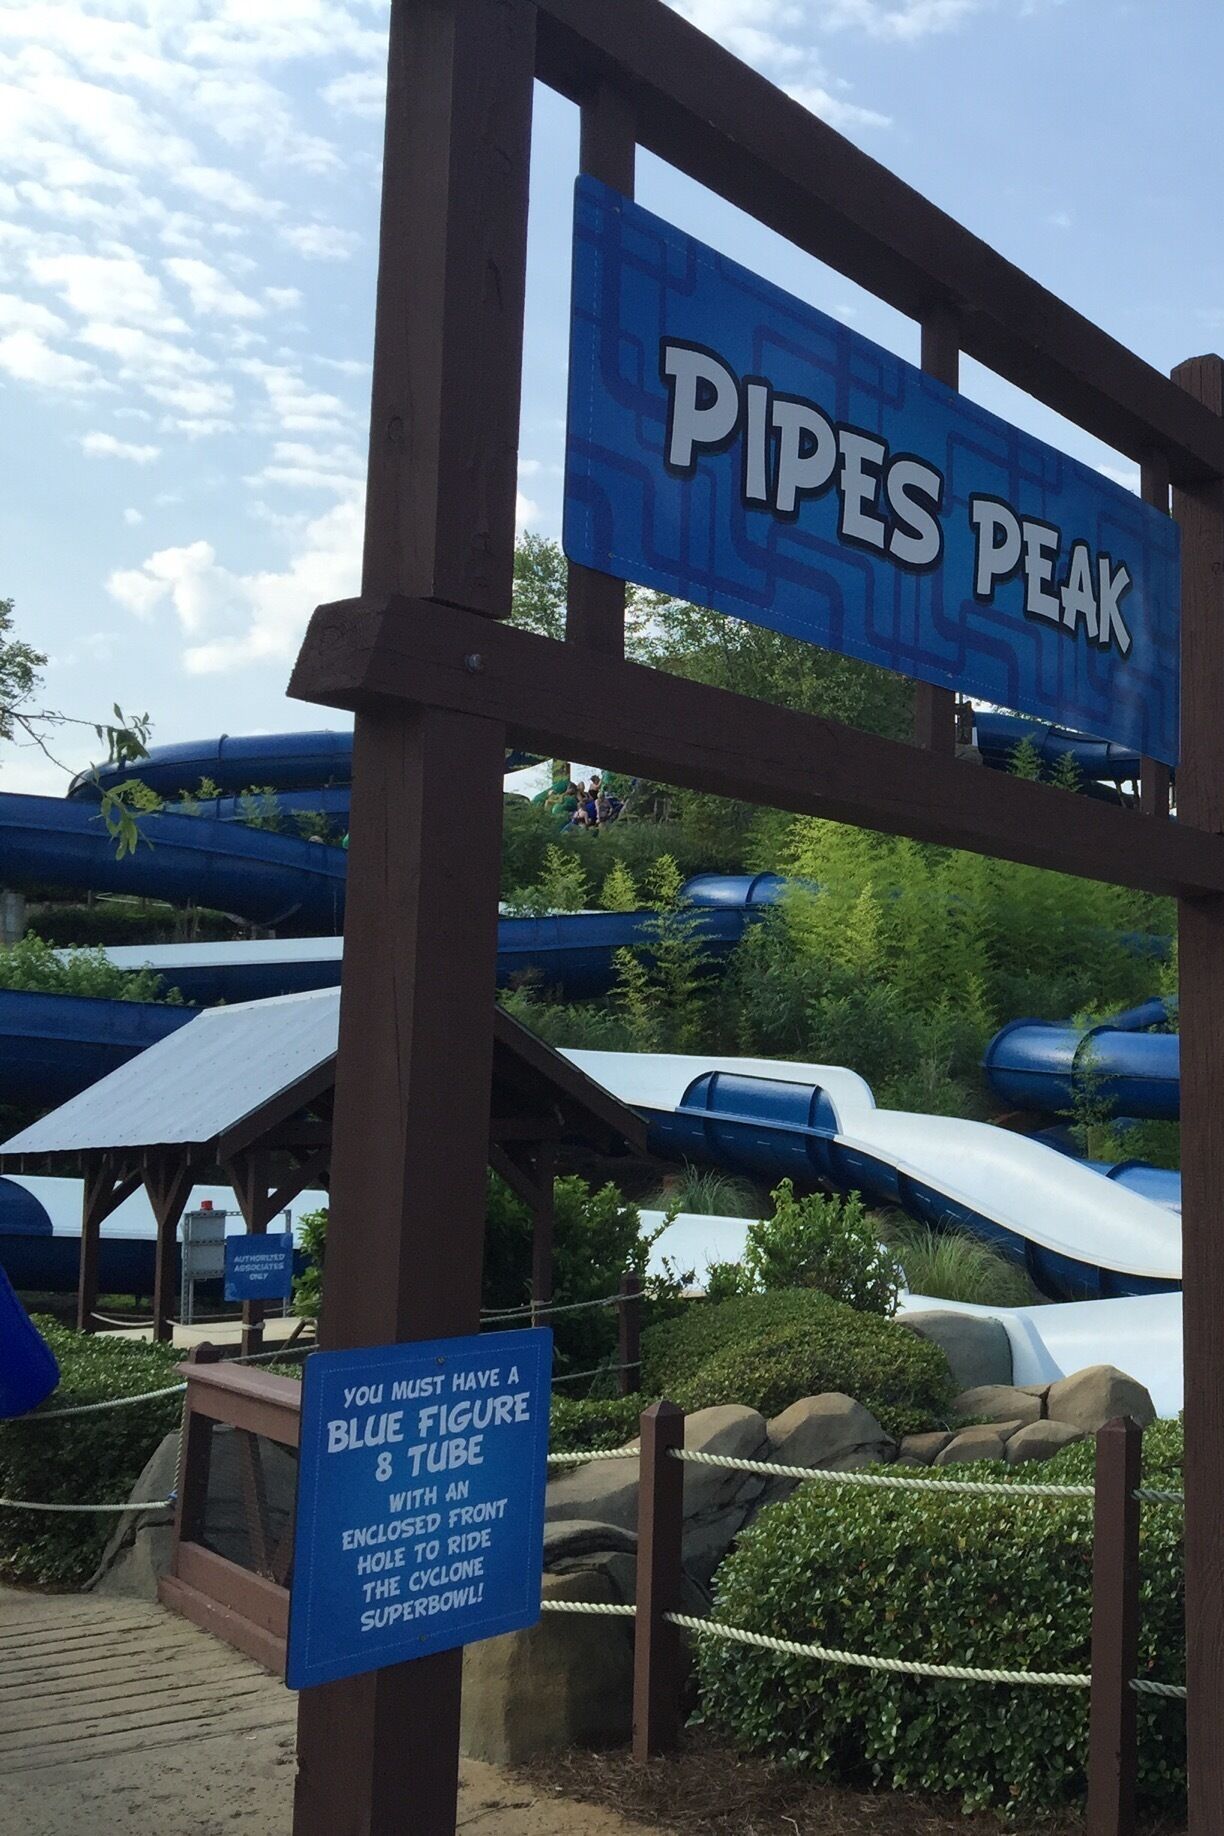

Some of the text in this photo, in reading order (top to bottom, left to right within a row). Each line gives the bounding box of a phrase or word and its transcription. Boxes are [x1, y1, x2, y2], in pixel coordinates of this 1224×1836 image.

[661, 340, 1133, 657] PIPES PEAK
[233, 1253, 286, 1263] AUTHORIZED
[233, 1261, 285, 1273] ASSOCIATES
[249, 1272, 269, 1281] ONLY
[344, 1365, 520, 1408] YOU MUST HAVE A
[327, 1392, 530, 1453] BLUE FIGURE
[375, 1434, 485, 1482] 8 TUBE
[389, 1480, 469, 1513] WITH AN
[342, 1499, 508, 1551] ENCLOSED FRONT
[357, 1528, 492, 1575] HOLE TO RIDE
[363, 1556, 485, 1603] THE CYCLONE
[360, 1582, 485, 1632] SUPERBOWL!
